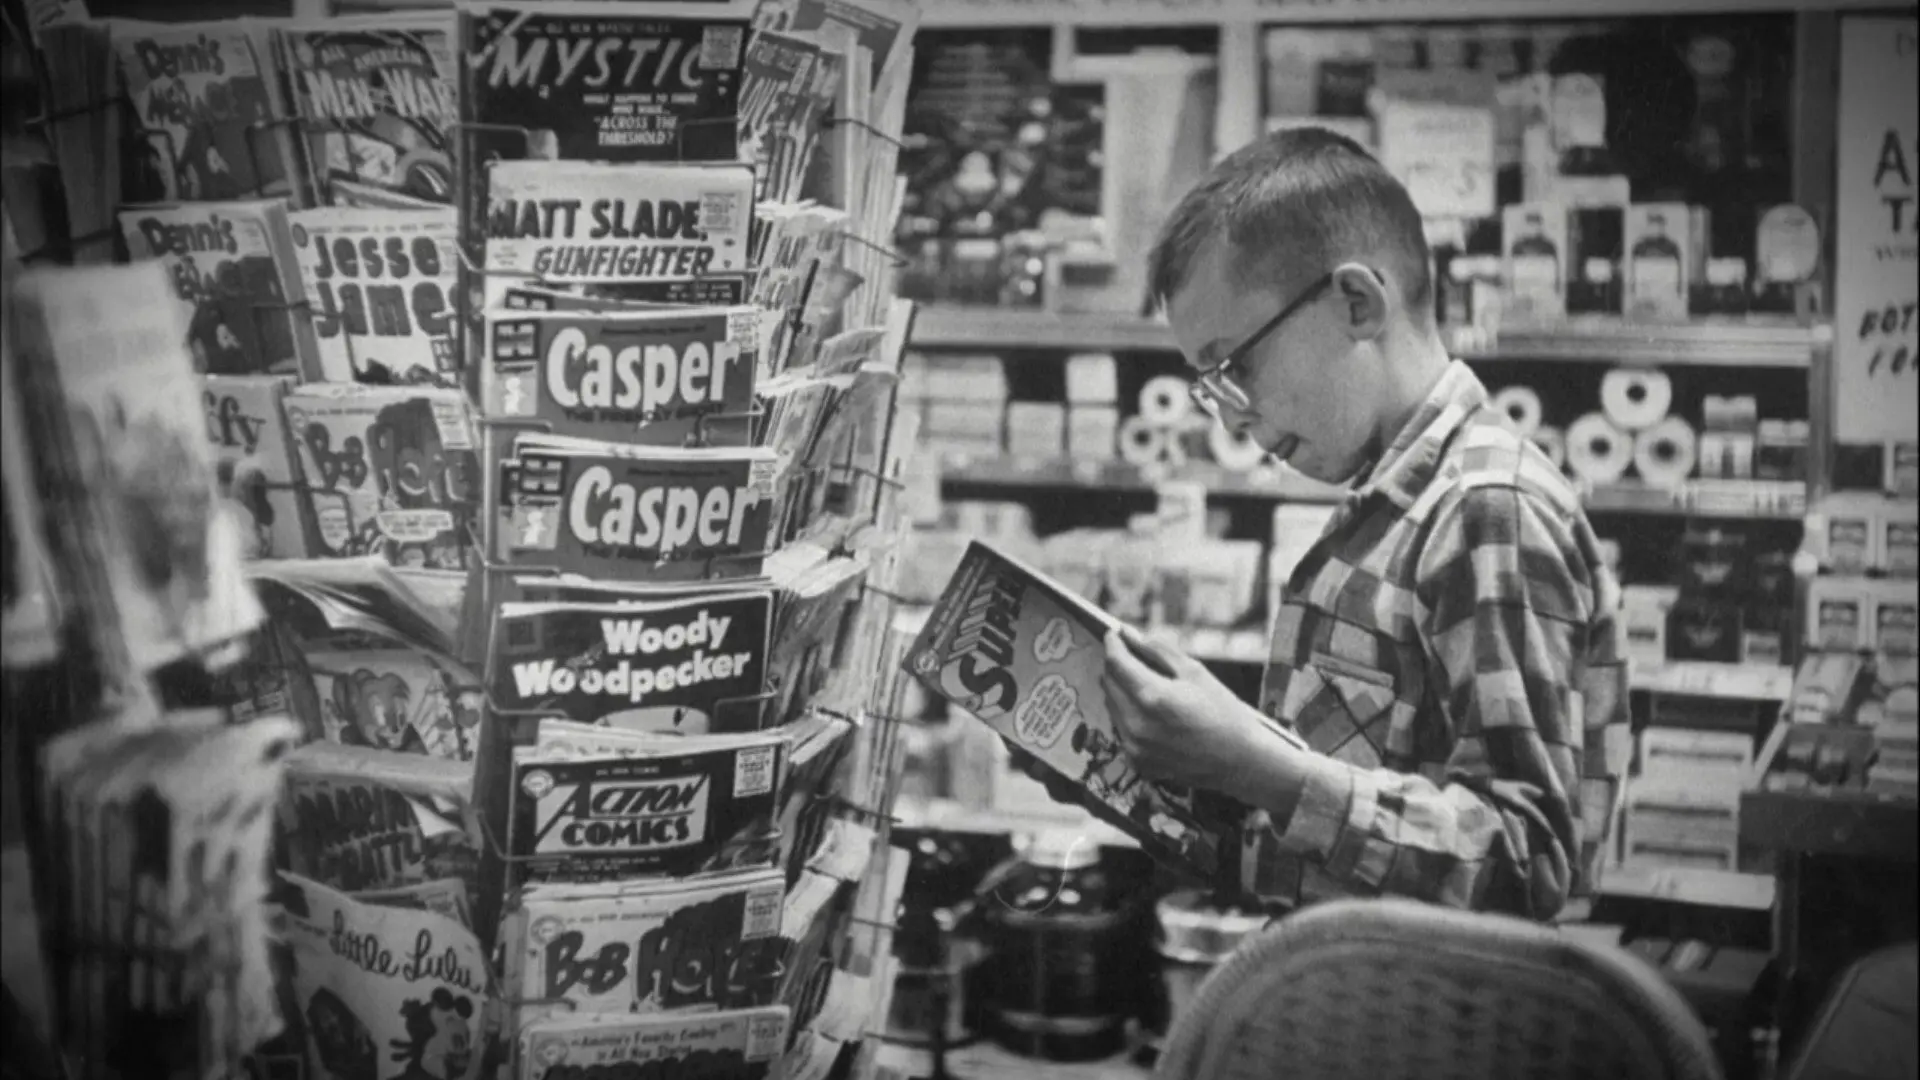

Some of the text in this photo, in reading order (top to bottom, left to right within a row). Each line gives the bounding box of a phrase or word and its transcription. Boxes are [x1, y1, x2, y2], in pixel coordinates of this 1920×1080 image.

[133, 33, 225, 78] Dennis
[490, 37, 702, 86] MYSTIC
[303, 69, 376, 118] MEN
[1873, 130, 1917, 187] A
[138, 213, 238, 256] Dennis
[489, 199, 581, 238] MATT
[314, 236, 440, 278] Jesse
[533, 245, 714, 278] GUNFIGHTER
[546, 327, 741, 412] Casper
[569, 466, 760, 552] Casper
[601, 611, 731, 654] Woody
[513, 650, 751, 701] Woodpecker
[537, 773, 706, 824] ACTION
[562, 815, 690, 848] COMICS
[404, 928, 481, 994] Lulu
